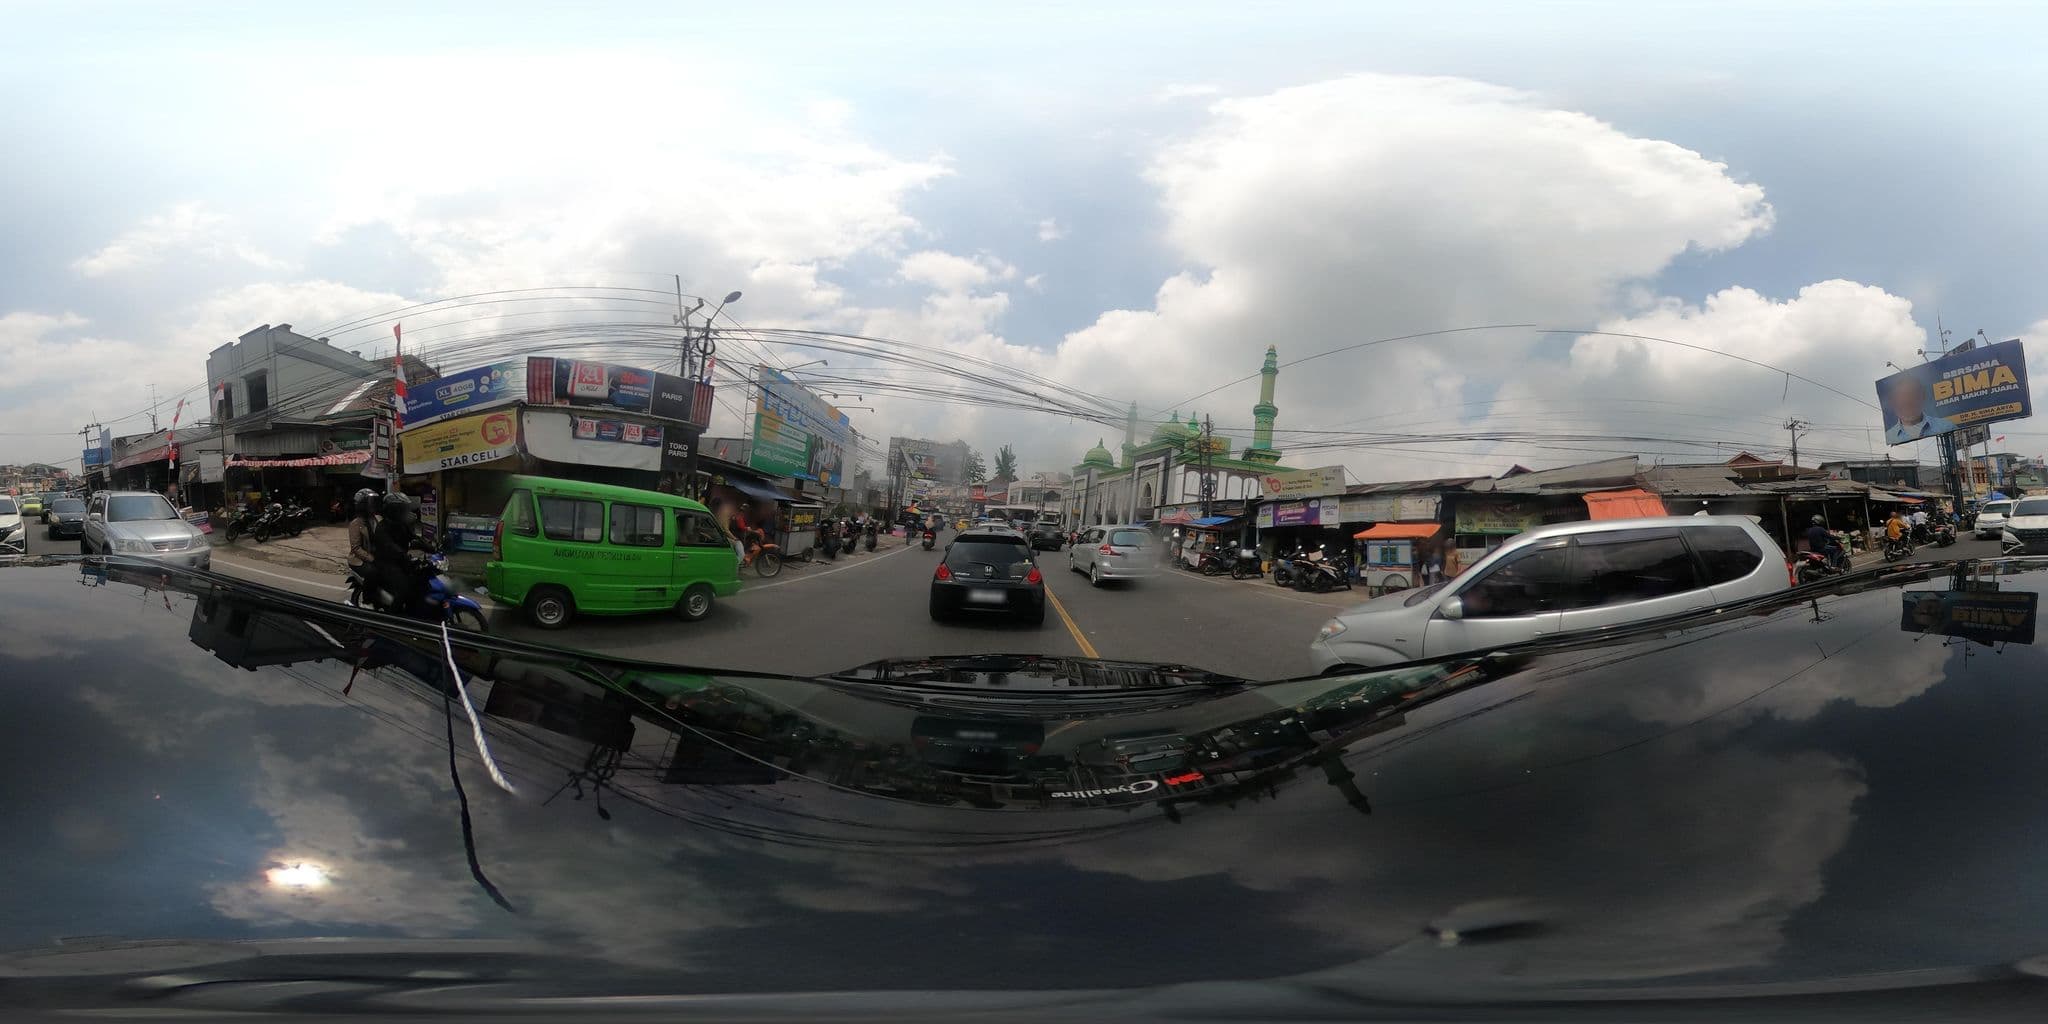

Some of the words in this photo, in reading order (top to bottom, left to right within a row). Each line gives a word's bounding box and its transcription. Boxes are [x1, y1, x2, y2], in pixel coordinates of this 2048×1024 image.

[1943, 359, 2000, 379] BERSAMA
[1932, 365, 2018, 401] BIMA
[438, 388, 450, 398] XL
[661, 392, 683, 401] PARIS
[1935, 396, 1960, 407] JABAR
[1961, 389, 1988, 401] MAKIN
[1990, 383, 2019, 395] JUARA
[668, 449, 688, 458] PARIS
[669, 442, 688, 450] TOKO
[440, 455, 469, 468] STAR
[471, 450, 500, 462] CELL
[1051, 780, 1159, 798] Crystalline
